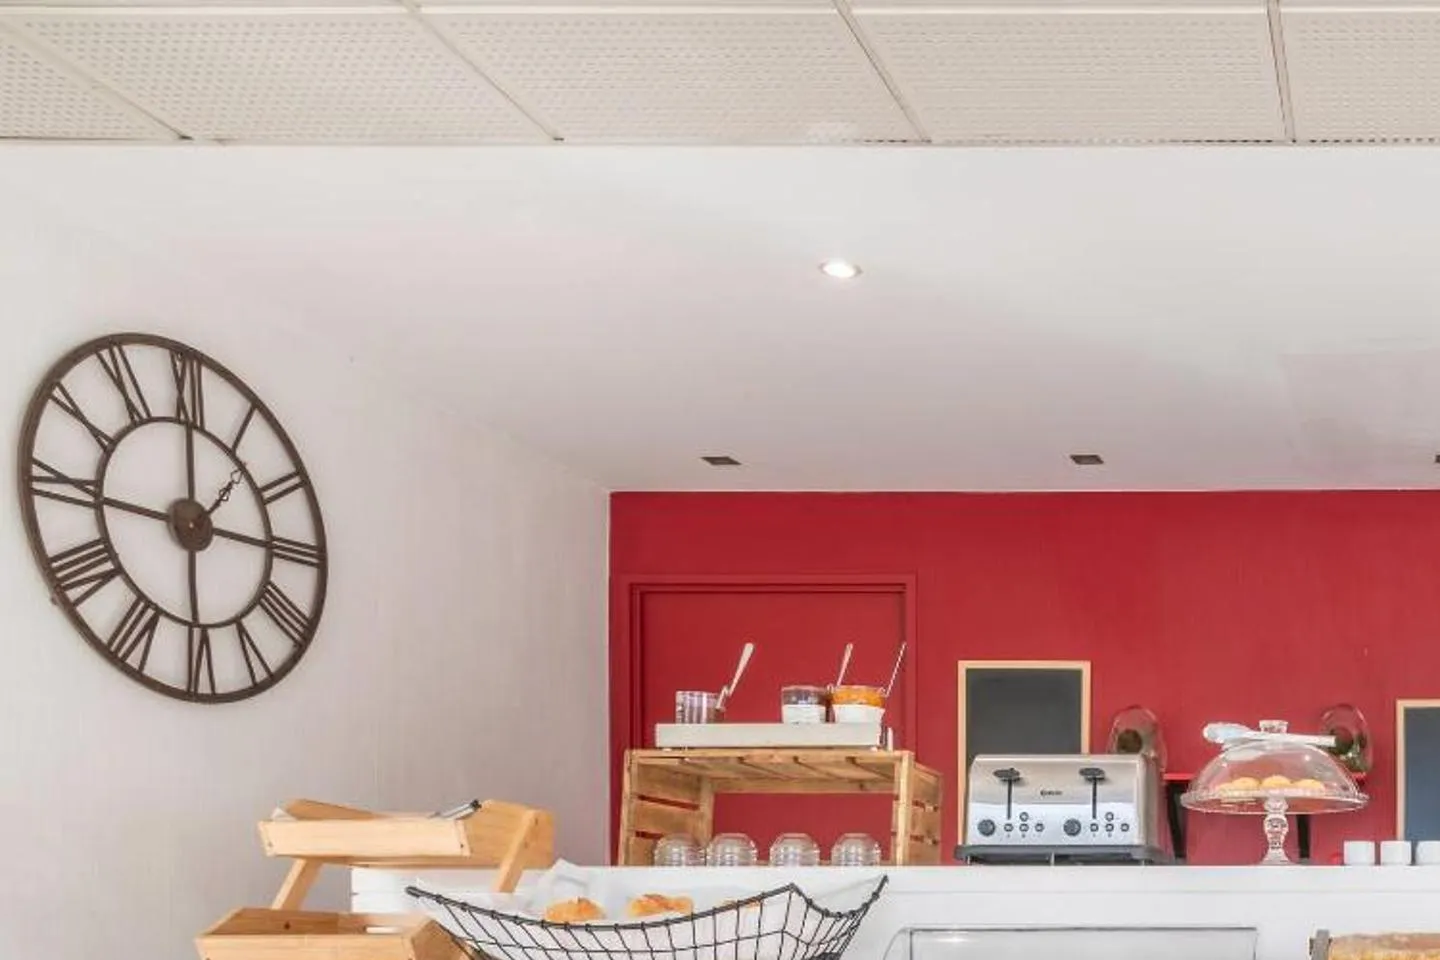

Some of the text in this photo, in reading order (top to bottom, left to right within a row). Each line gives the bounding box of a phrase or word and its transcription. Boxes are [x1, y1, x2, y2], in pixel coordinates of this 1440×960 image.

[49, 380, 114, 452] X
[95, 342, 150, 427] XI
[170, 350, 206, 432] XII
[30, 456, 102, 510] IX
[259, 470, 308, 507] II
[49, 537, 122, 608] VIII
[270, 536, 326, 568] III
[106, 596, 161, 674] VII
[187, 624, 217, 696] VI
[236, 617, 275, 687] V
